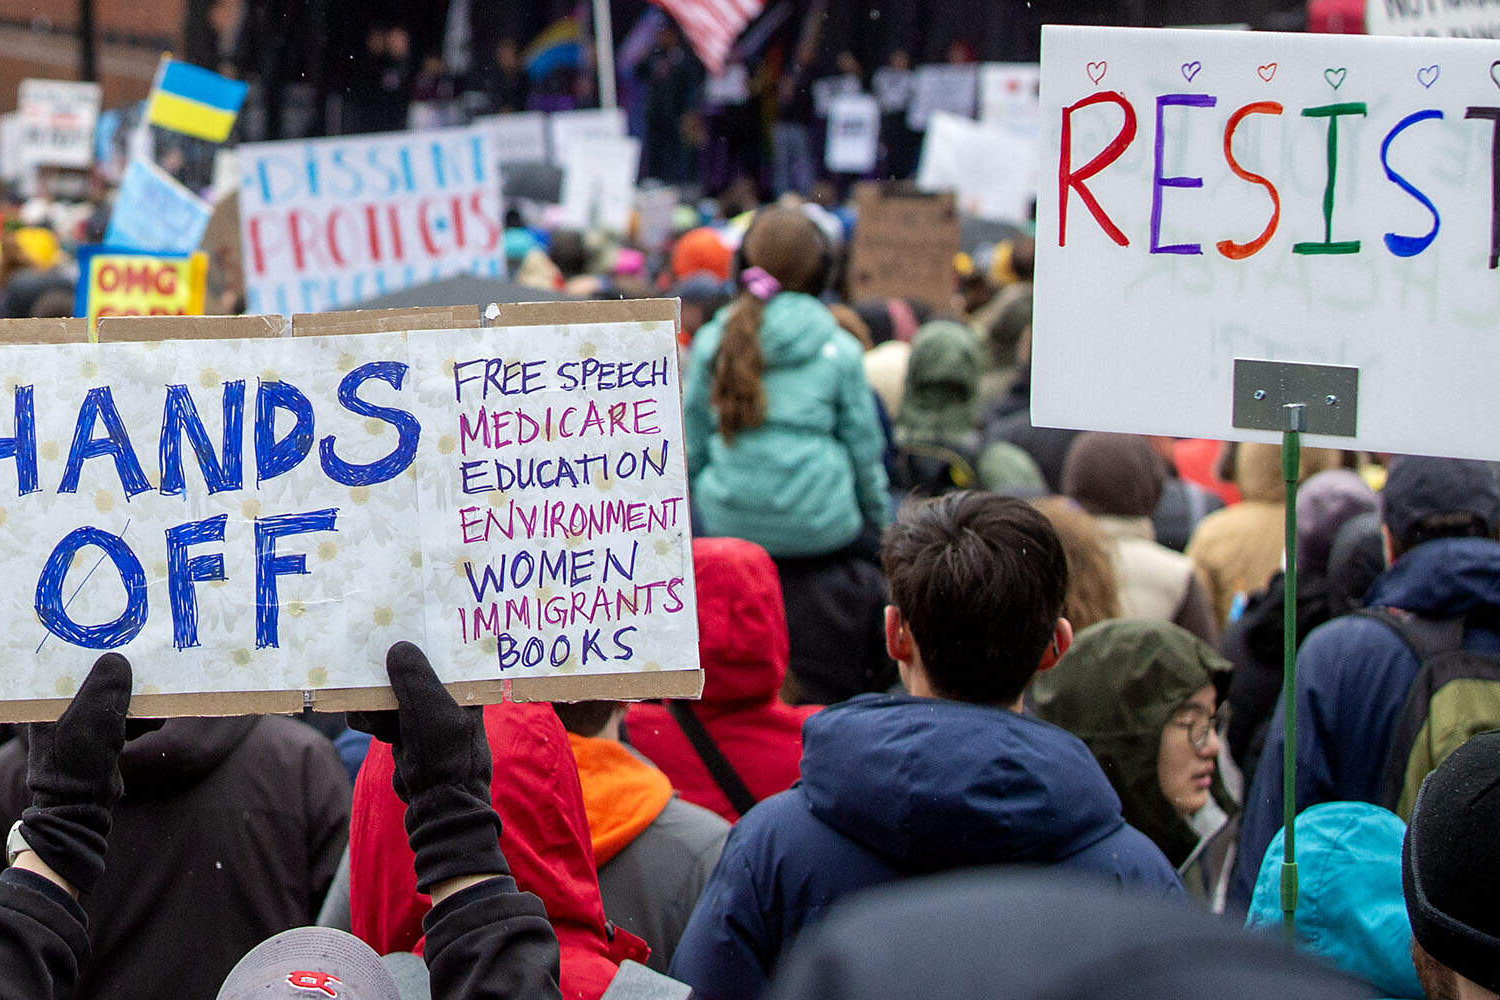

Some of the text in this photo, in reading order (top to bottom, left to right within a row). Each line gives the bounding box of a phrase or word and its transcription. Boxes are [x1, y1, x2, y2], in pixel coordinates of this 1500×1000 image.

[256, 133, 486, 204] DISSENT
[248, 187, 500, 275] PROTECTS
[97, 263, 179, 296] OMG
[454, 357, 667, 402] FREE SPEECH
[459, 399, 661, 455] MEDICARE
[459, 440, 669, 494] EDUCATION
[459, 497, 683, 543] ENVIRONMENT
[35, 508, 340, 652] OFF
[464, 540, 638, 602] WOMEN
[458, 577, 684, 644] IMMIGRANTS
[498, 626, 638, 671] BOOKS
